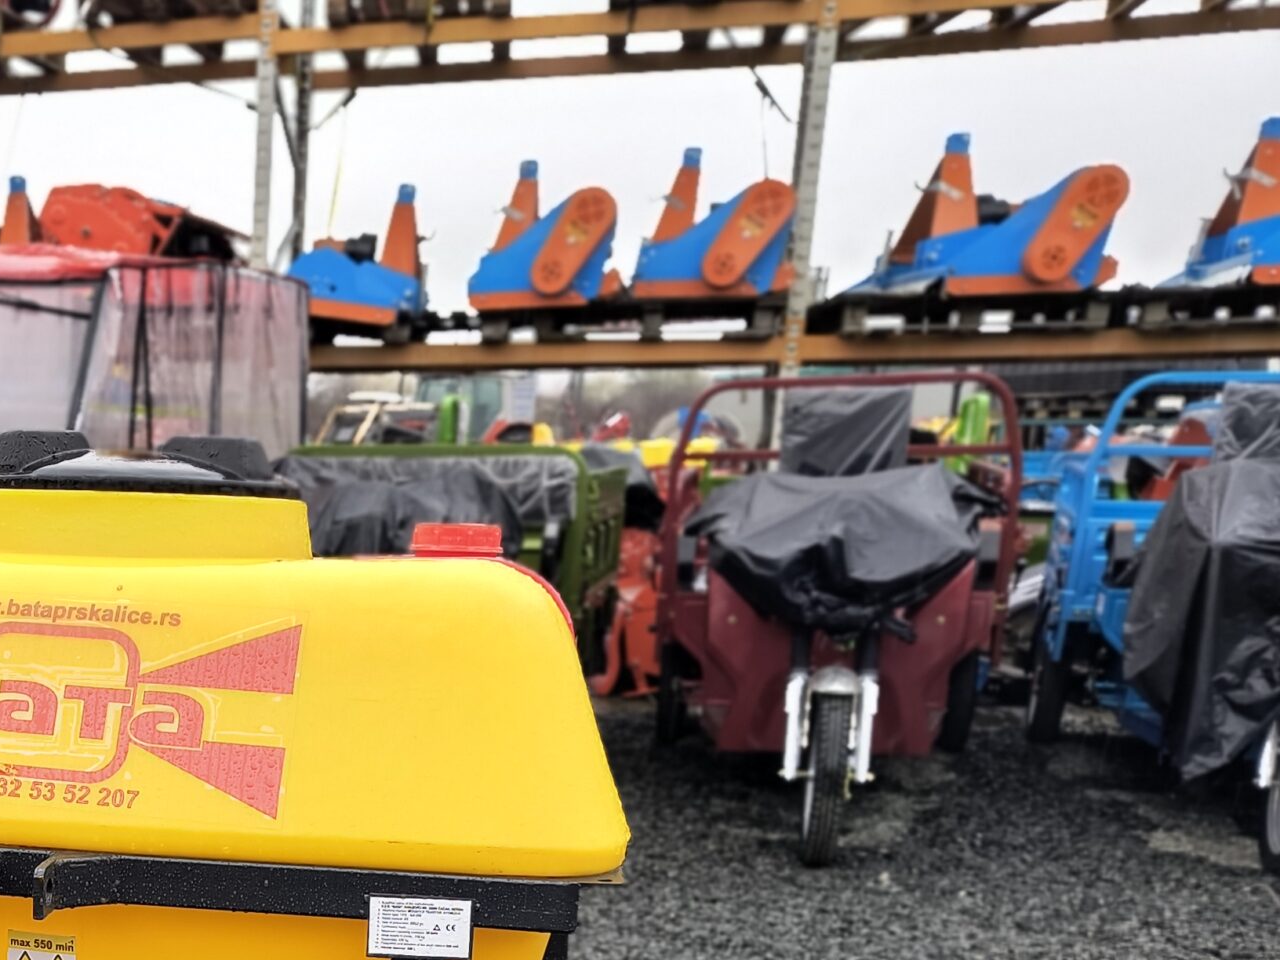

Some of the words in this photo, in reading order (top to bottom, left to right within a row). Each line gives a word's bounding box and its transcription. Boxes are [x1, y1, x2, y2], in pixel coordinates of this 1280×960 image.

[28, 781, 56, 801] 53
[62, 784, 91, 805] 52
[97, 787, 140, 809] 207
[10, 938, 31, 947] max
[33, 939, 53, 950] 550
